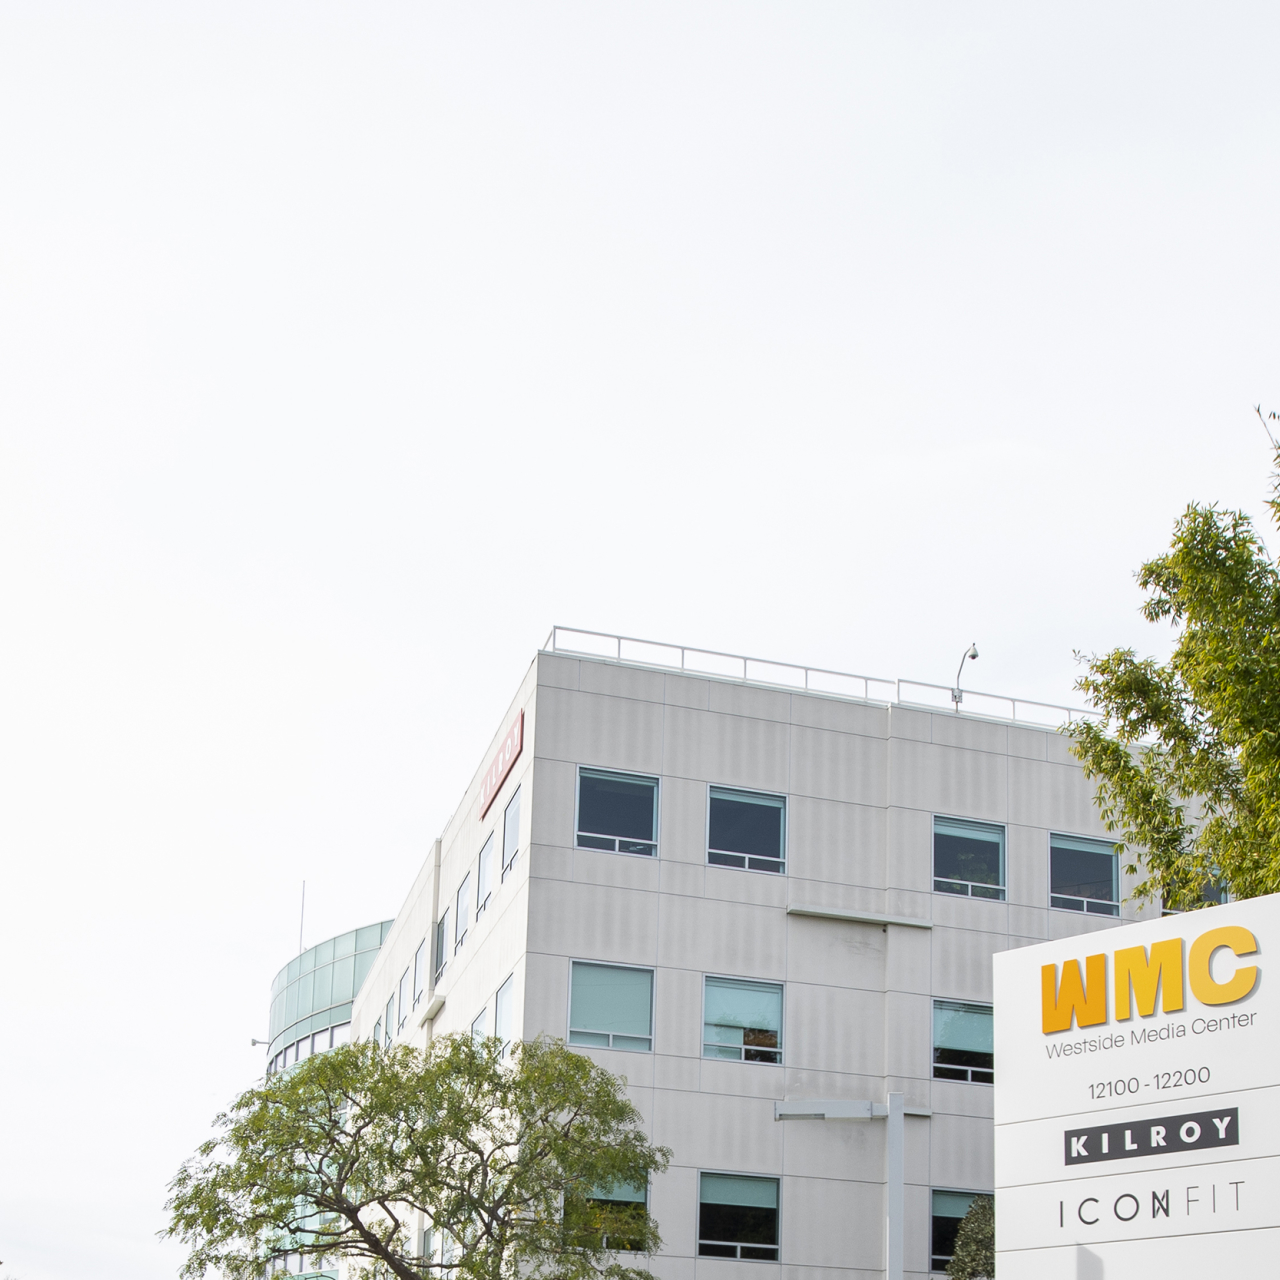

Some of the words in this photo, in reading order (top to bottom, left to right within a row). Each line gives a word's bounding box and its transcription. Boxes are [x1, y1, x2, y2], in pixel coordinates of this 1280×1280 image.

[480, 721, 520, 808] KILROY
[1041, 925, 1260, 1035] WMC
[1046, 1033, 1125, 1059] Westside
[1130, 1022, 1186, 1046] Media
[1191, 1012, 1258, 1035] Center
[1088, 1077, 1140, 1100] 12100
[1153, 1066, 1211, 1090] 12200
[1071, 1116, 1232, 1158] KILROY
